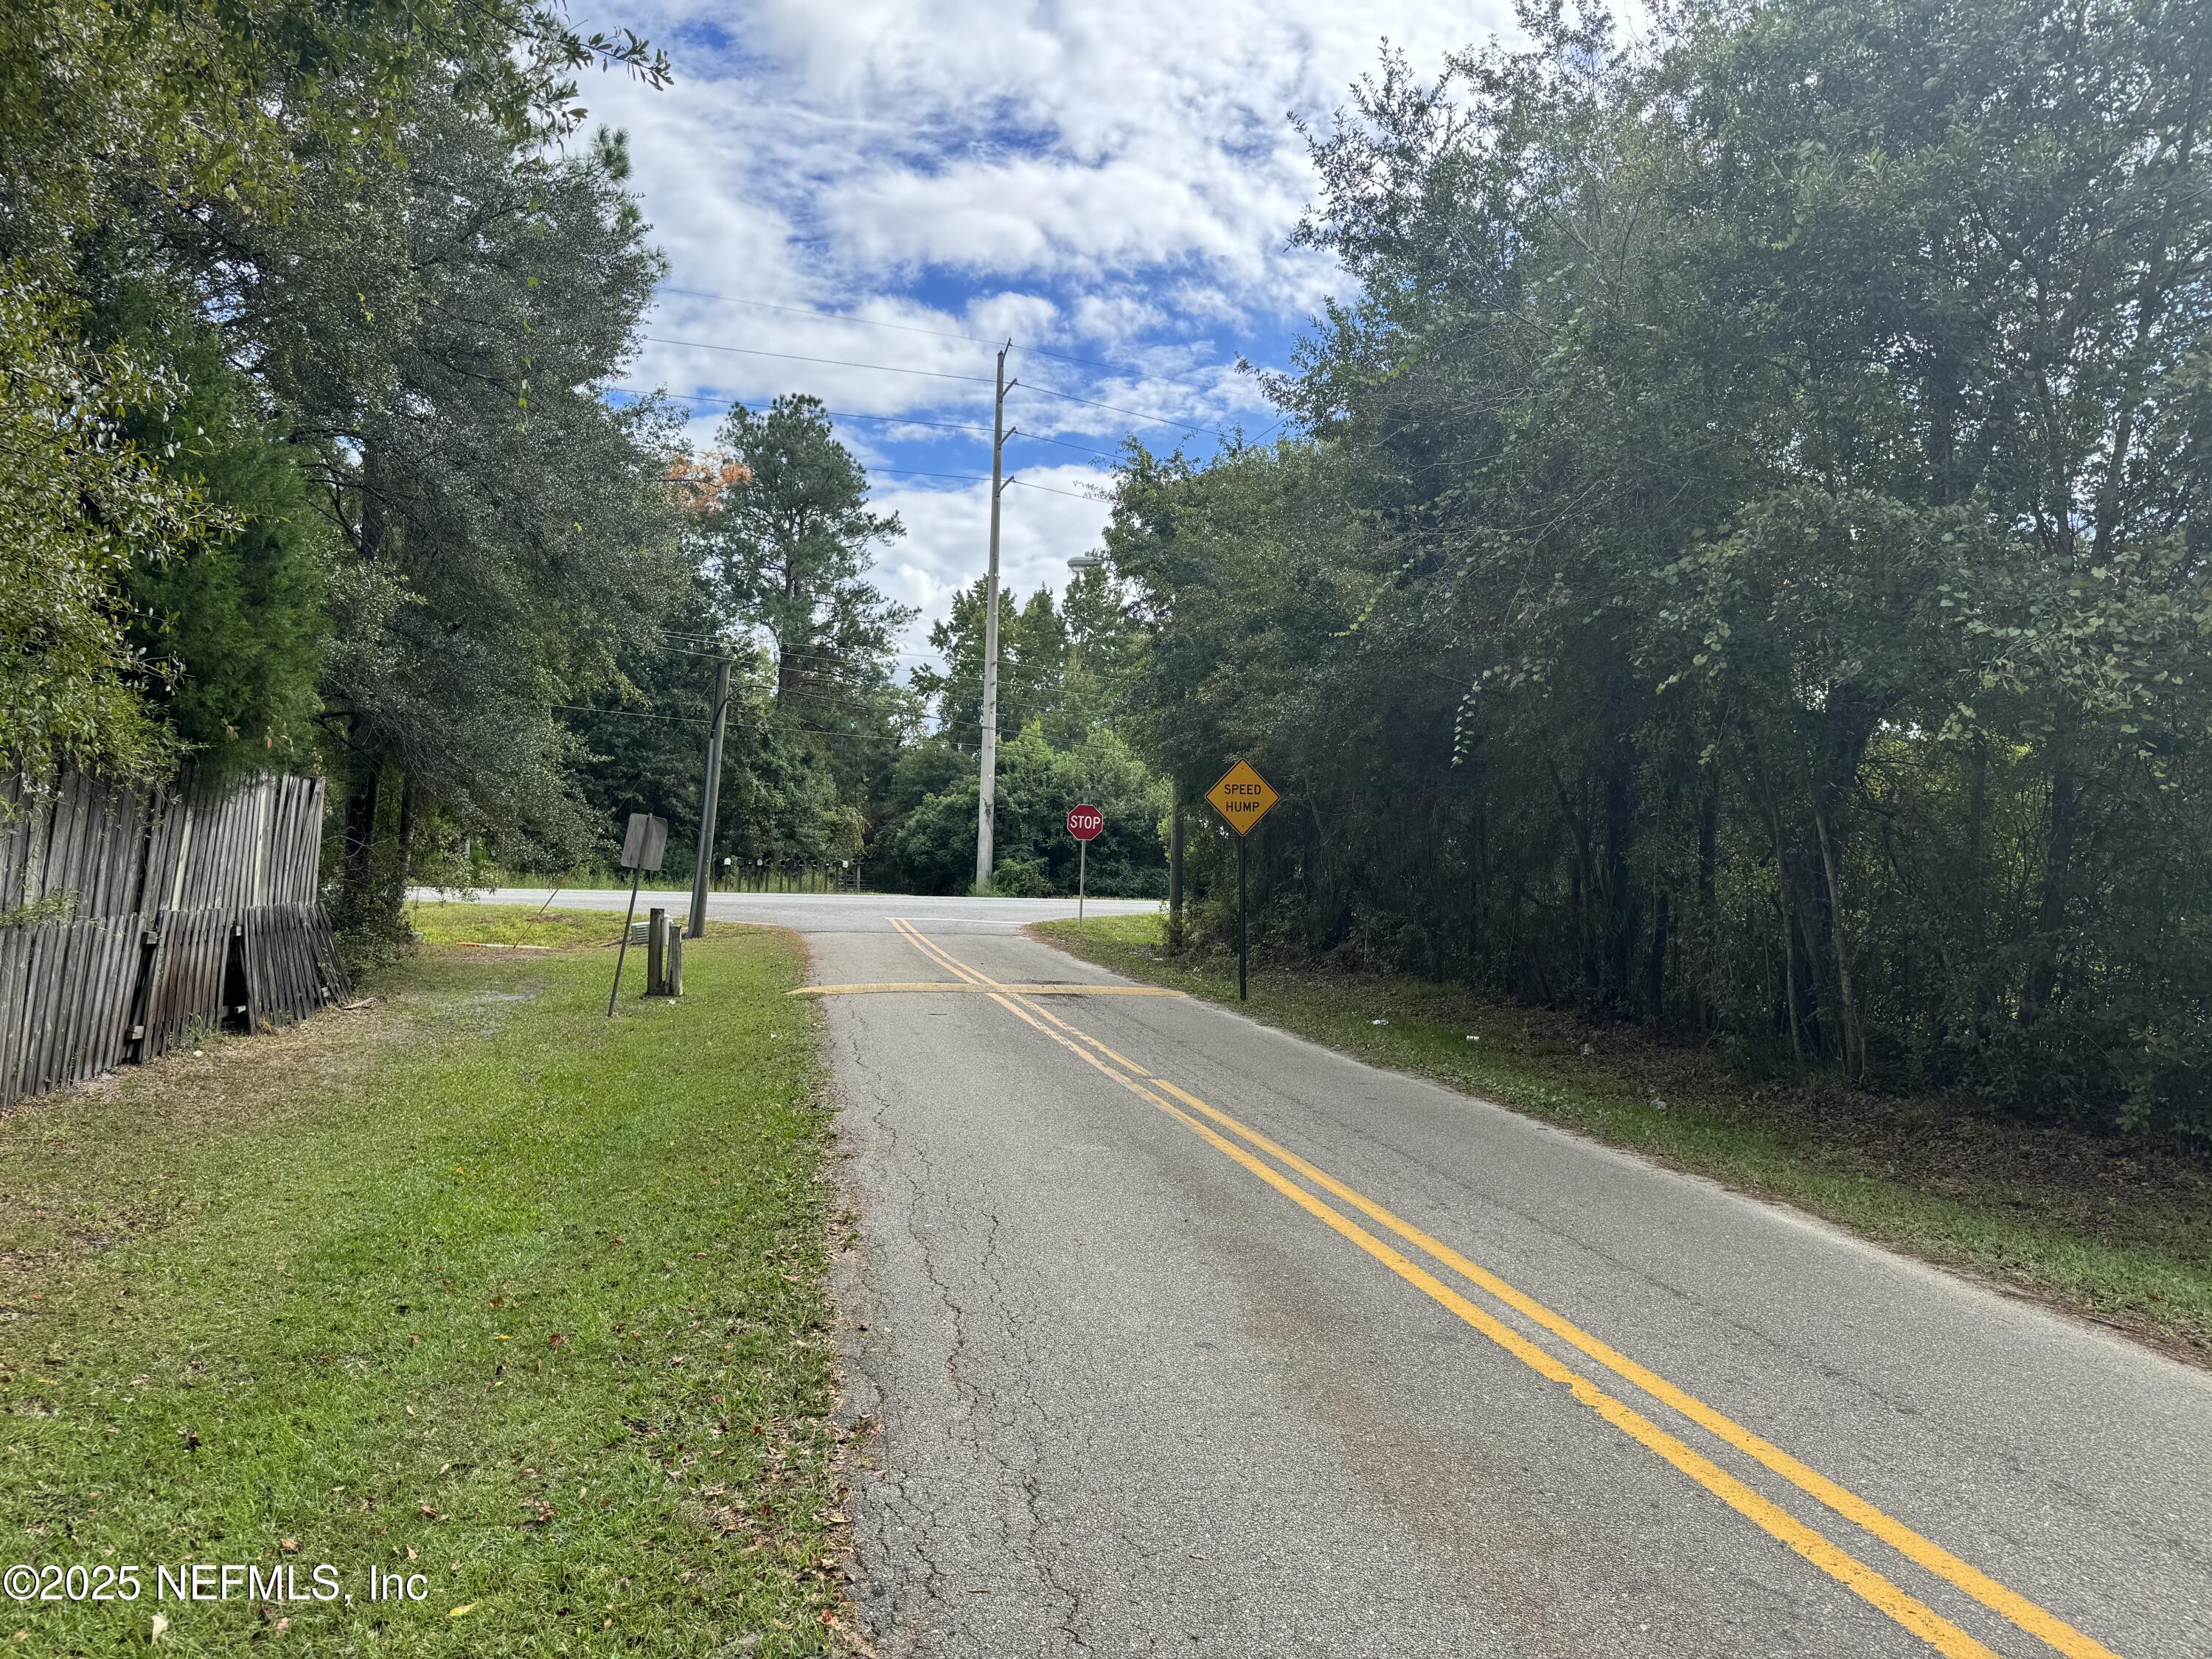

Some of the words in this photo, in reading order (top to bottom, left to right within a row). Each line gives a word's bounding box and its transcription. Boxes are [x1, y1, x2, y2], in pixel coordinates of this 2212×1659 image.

[1224, 784, 1262, 795] SPEED
[1226, 801, 1259, 812] HUMP
[1070, 815, 1101, 830] STOP
